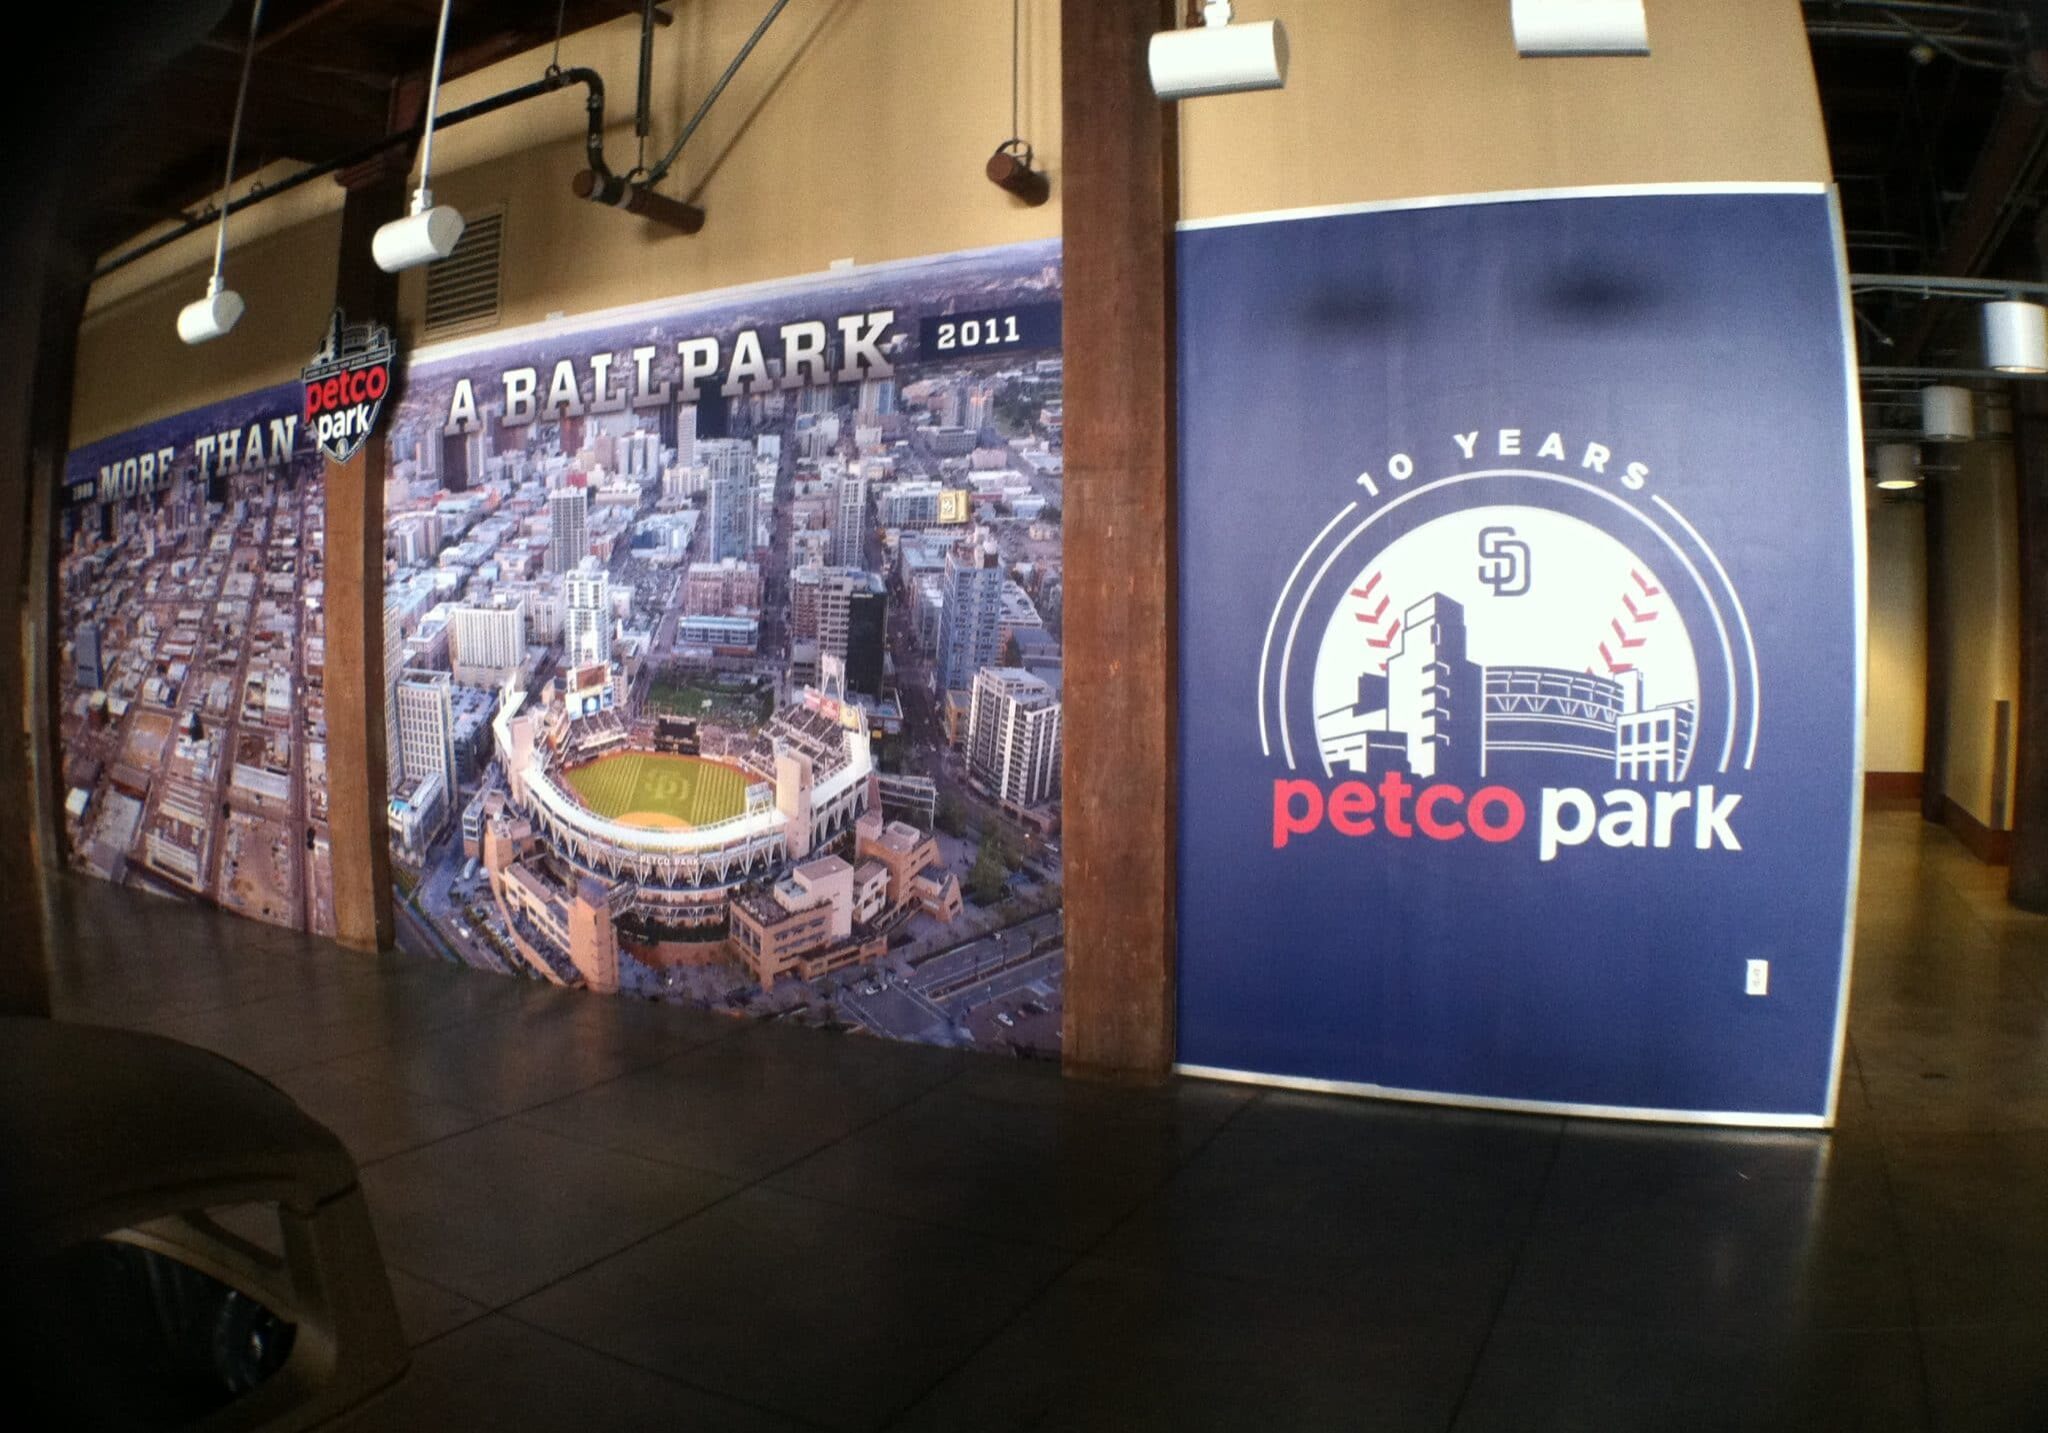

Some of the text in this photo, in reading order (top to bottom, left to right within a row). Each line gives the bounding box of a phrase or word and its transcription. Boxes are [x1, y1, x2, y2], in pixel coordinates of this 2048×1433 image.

[937, 315, 1020, 350] 2011
[304, 365, 388, 426] petco
[444, 310, 895, 437] A BALLPARK
[100, 414, 298, 503] MORE THAN
[317, 403, 370, 450] park
[1357, 429, 1650, 497] 10 YEARS
[1272, 770, 1743, 862] petco park
